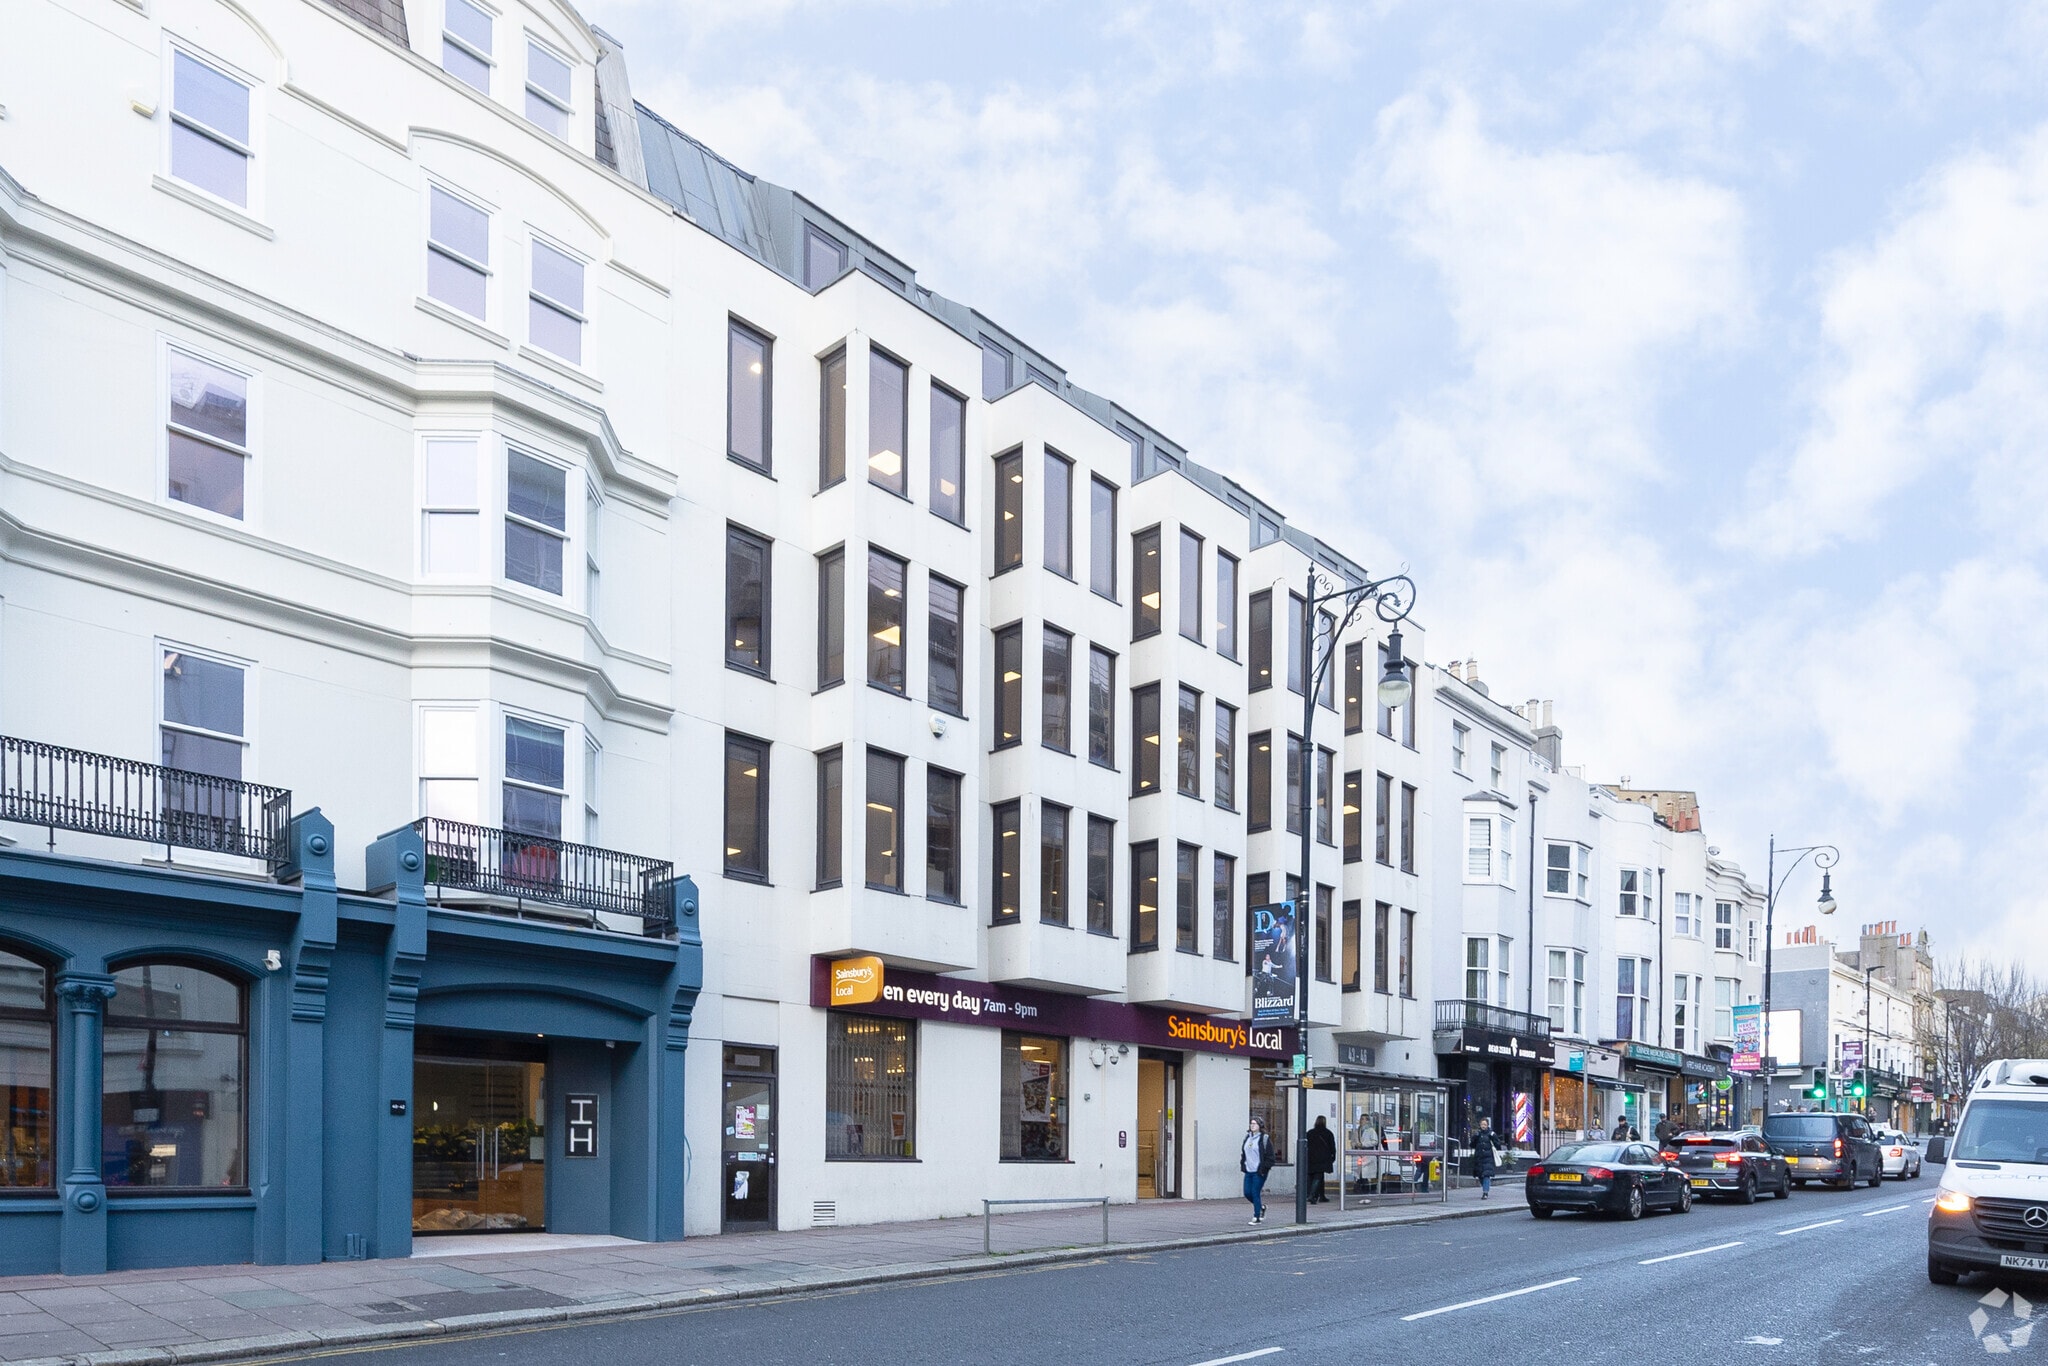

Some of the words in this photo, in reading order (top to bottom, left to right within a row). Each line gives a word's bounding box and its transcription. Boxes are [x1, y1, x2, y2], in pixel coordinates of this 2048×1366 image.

[836, 966, 872, 979] Sainsbury's
[836, 985, 854, 996] Local
[883, 985, 903, 1001] en
[906, 988, 950, 1012] every
[952, 990, 980, 1015] day
[983, 998, 1006, 1013] 7am
[1014, 1002, 1037, 1018] 9pm
[1255, 995, 1293, 1008] Blizzard
[1168, 1015, 1247, 1049] Sainsbury's
[1249, 1026, 1282, 1050] Local
[2005, 1256, 2034, 1267] NK74
